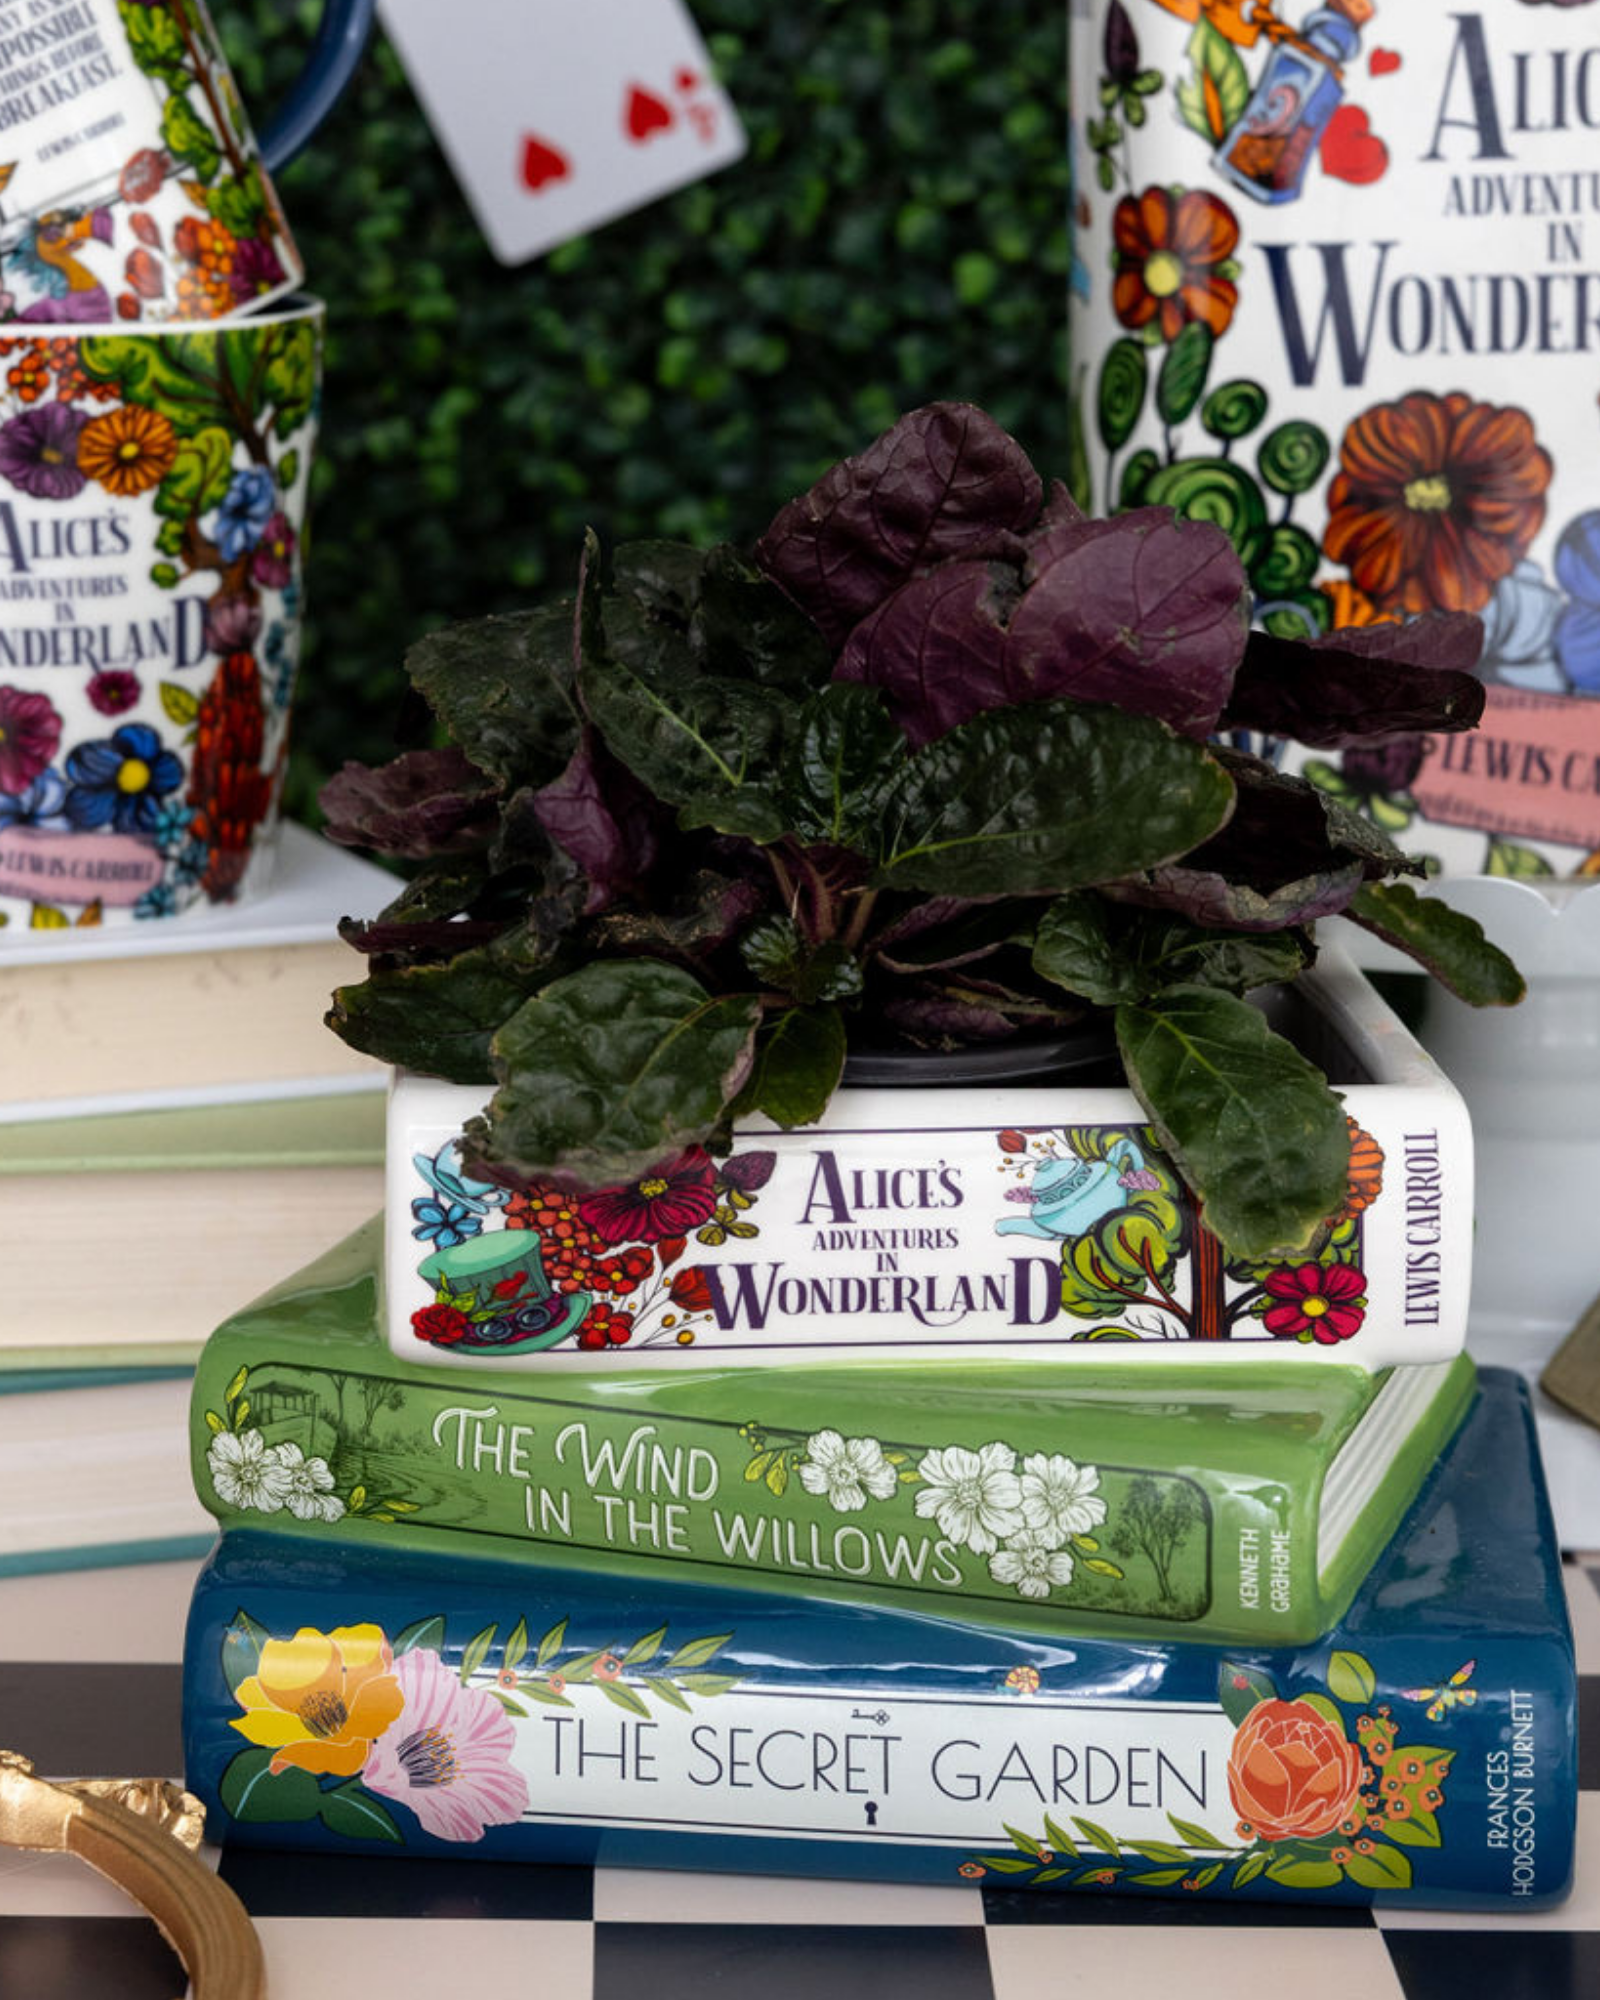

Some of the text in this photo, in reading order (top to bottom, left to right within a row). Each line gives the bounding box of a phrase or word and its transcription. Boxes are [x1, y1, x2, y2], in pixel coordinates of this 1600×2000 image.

[1547, 221, 1582, 263] IN
[55, 602, 75, 623] IN
[1442, 732, 1554, 786] LEWIS
[796, 1150, 964, 1224] ALICE'S
[1403, 1128, 1442, 1326] LEWIS CARROLL
[812, 1228, 959, 1251] ADVENTURES
[876, 1252, 899, 1273] IN
[697, 1257, 1063, 1331] WONDERLAND
[432, 1405, 719, 1501] THE WIND
[525, 1485, 963, 1587] IN THE WILLOWS
[1239, 1528, 1260, 1610] KENNETH
[1269, 1529, 1291, 1613] GRAHAME
[543, 1716, 1207, 1810] THE SECRET GARDEN
[1487, 1750, 1509, 1849] FRANCES
[1510, 1689, 1535, 1897] HODGSON BURNETT
